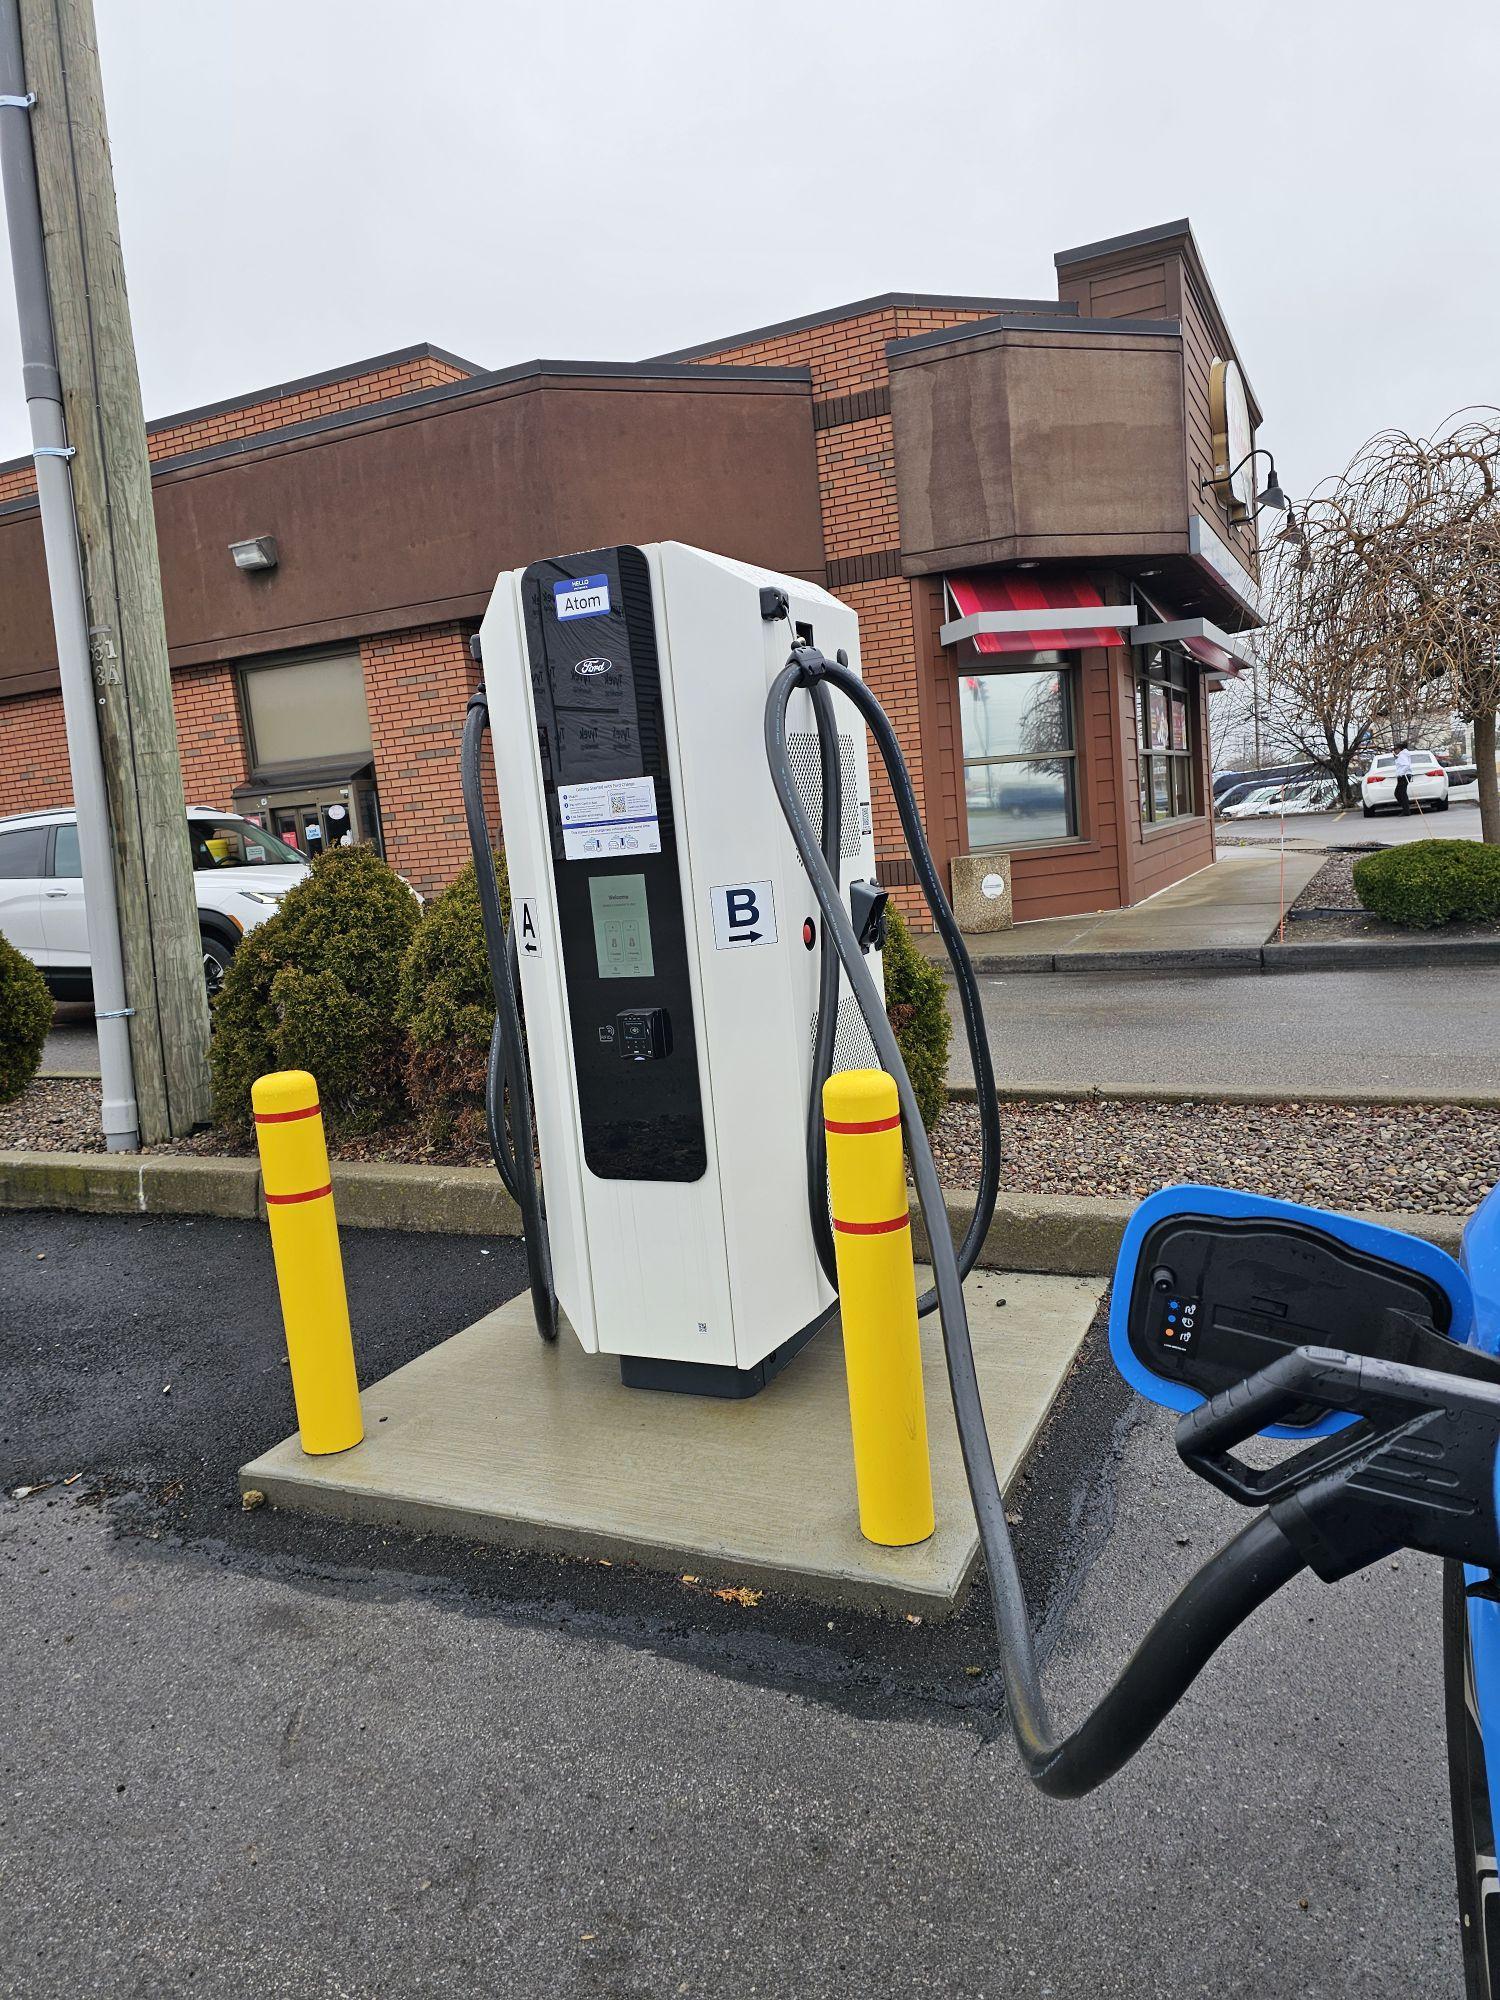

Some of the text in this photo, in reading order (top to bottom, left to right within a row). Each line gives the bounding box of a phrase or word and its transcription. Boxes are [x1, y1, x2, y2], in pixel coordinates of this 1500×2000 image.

[571, 579, 589, 587] HELLO
[565, 595, 601, 611] Atom
[581, 659, 605, 674] Ford
[726, 888, 760, 928] B
[523, 903, 536, 938] A
